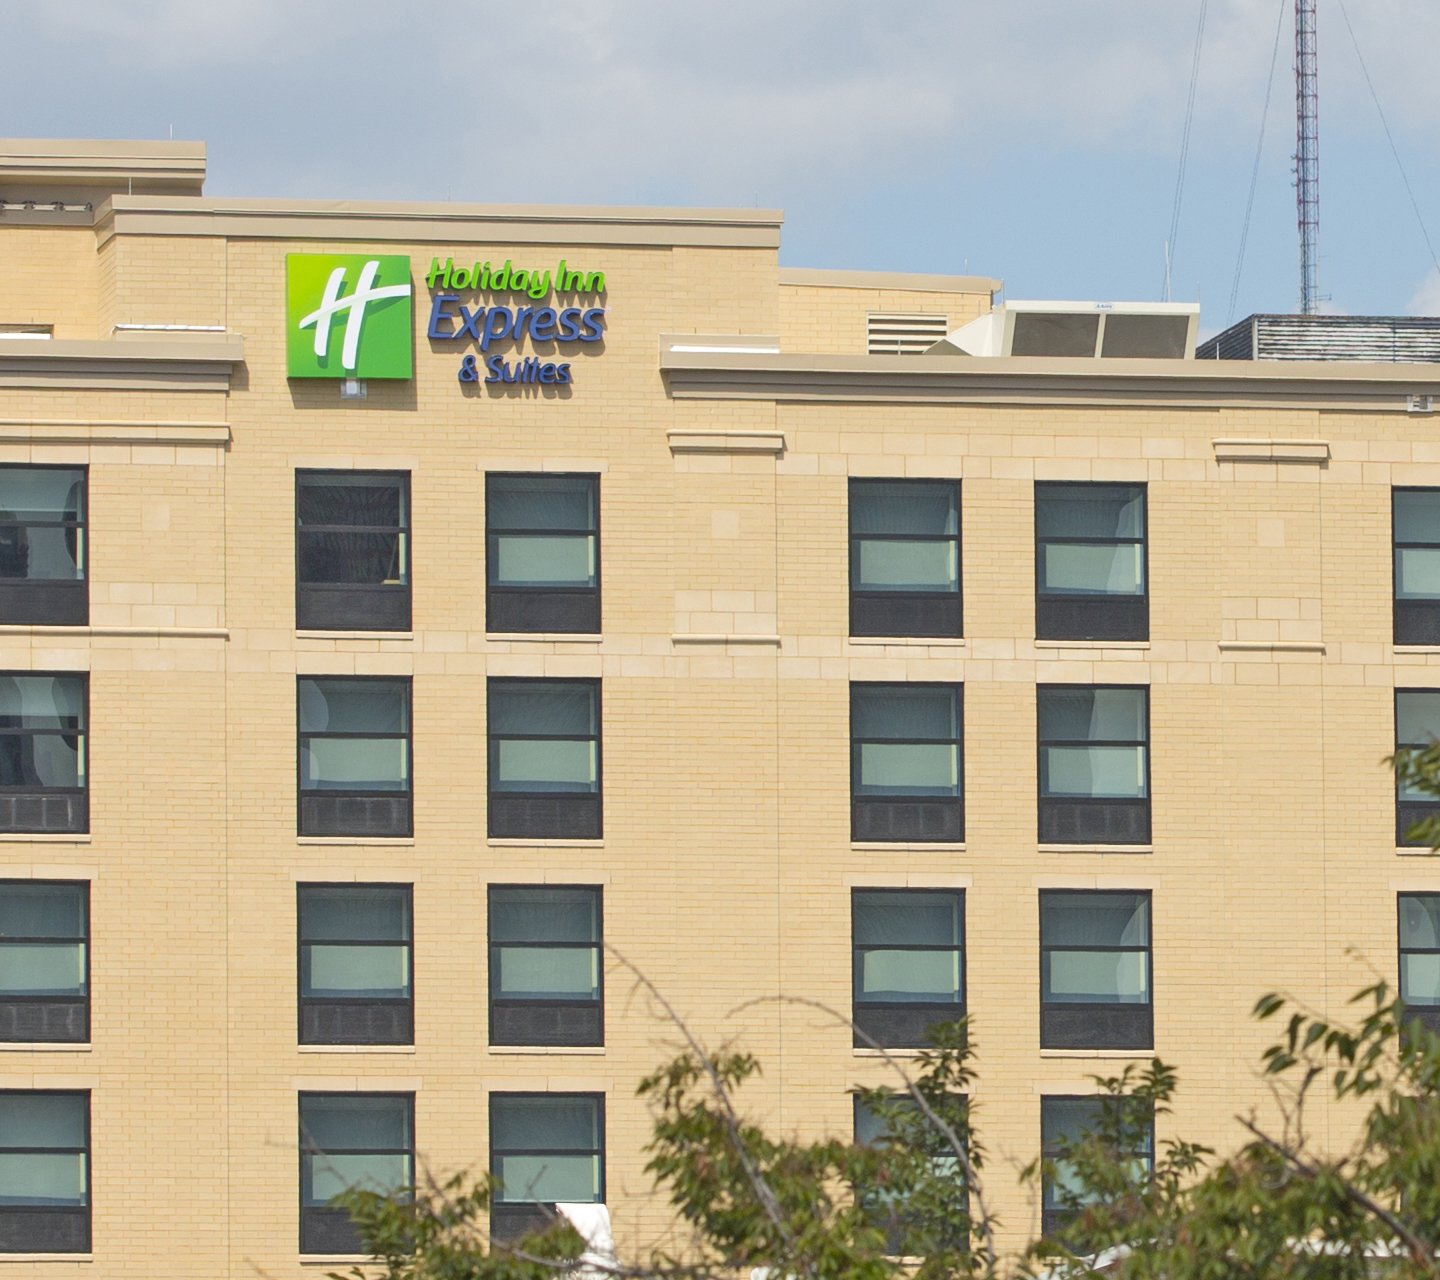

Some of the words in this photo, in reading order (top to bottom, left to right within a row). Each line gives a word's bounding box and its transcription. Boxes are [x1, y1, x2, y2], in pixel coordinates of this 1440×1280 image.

[426, 257, 549, 299] Holiday
[555, 260, 605, 293] Inn
[427, 294, 605, 351] Express
[458, 355, 478, 383] &
[485, 355, 571, 384] Suites
